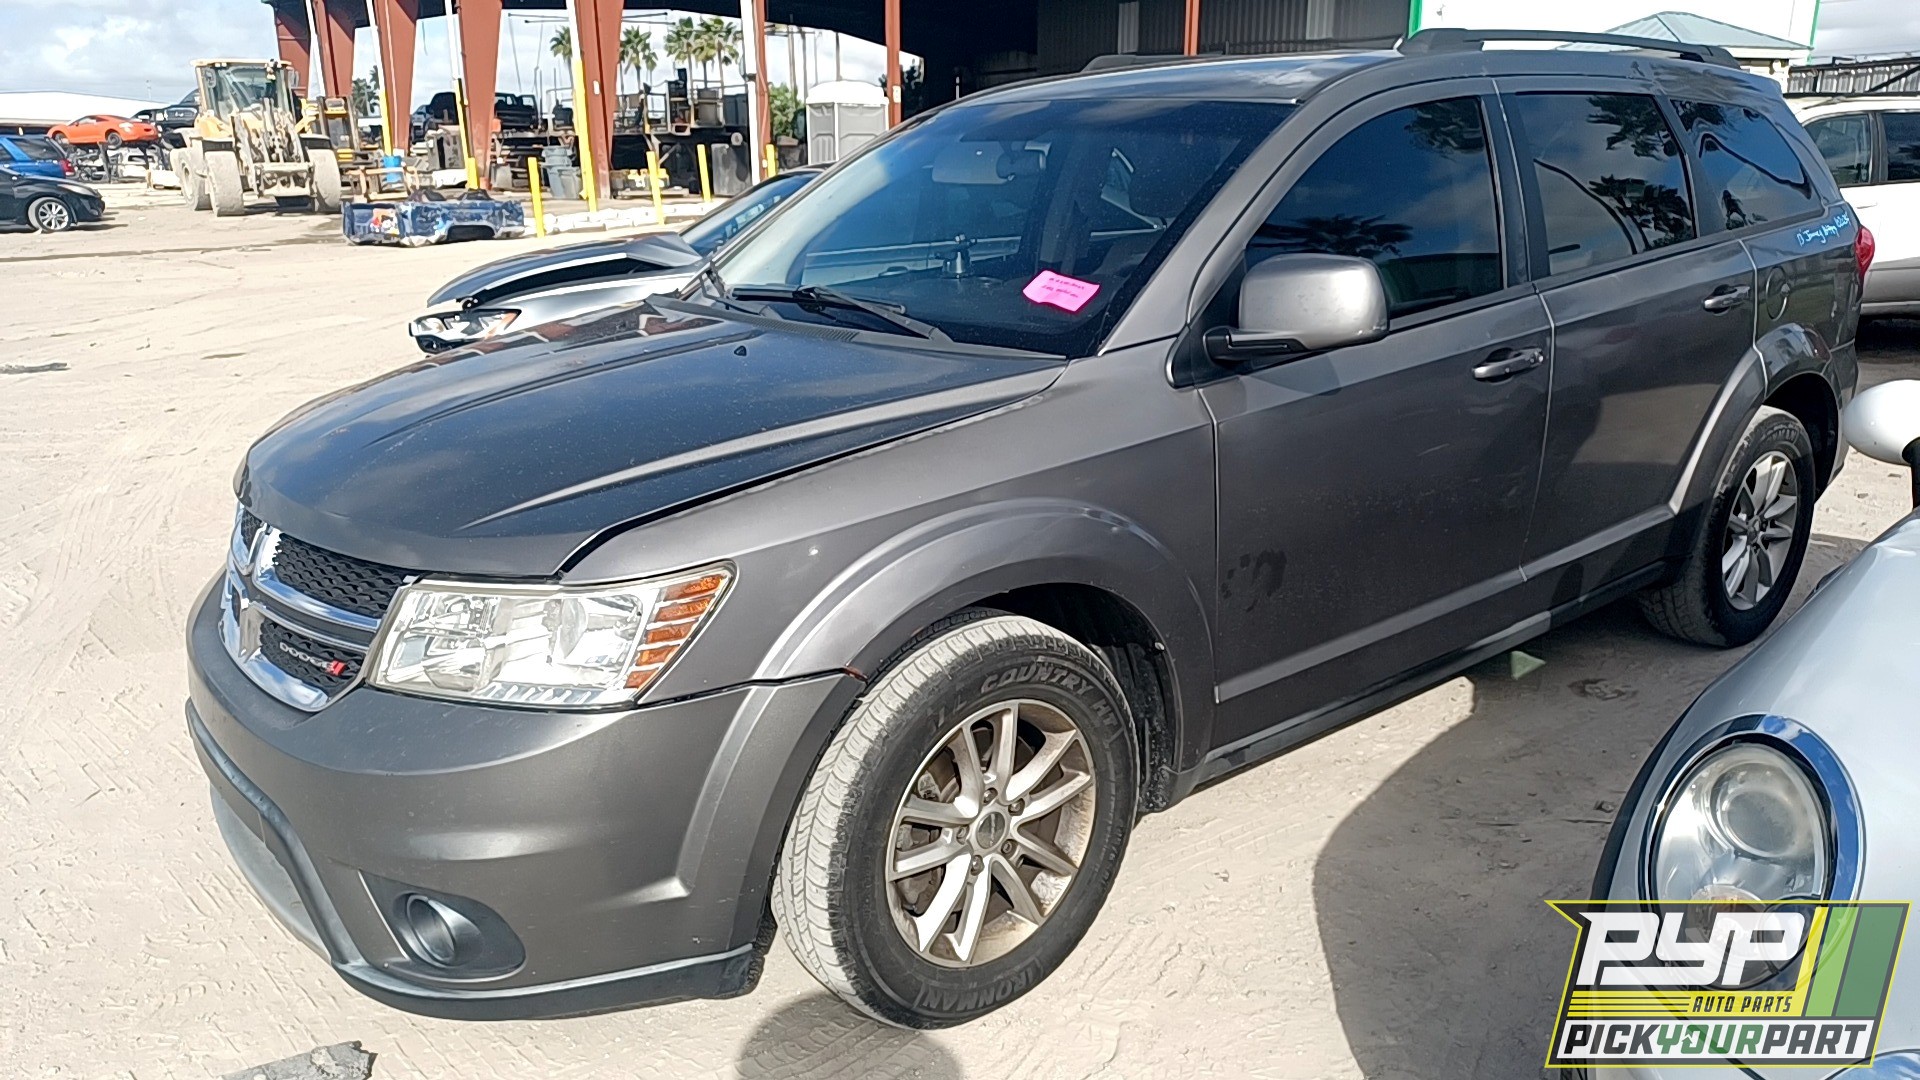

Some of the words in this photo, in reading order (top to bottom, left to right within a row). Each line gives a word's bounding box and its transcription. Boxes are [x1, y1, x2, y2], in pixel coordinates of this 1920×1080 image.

[280, 642, 333, 671] DODGE
[981, 664, 1094, 696] COUNTRY
[1092, 700, 1118, 727] HT
[923, 968, 1034, 1011] IRONMAN
